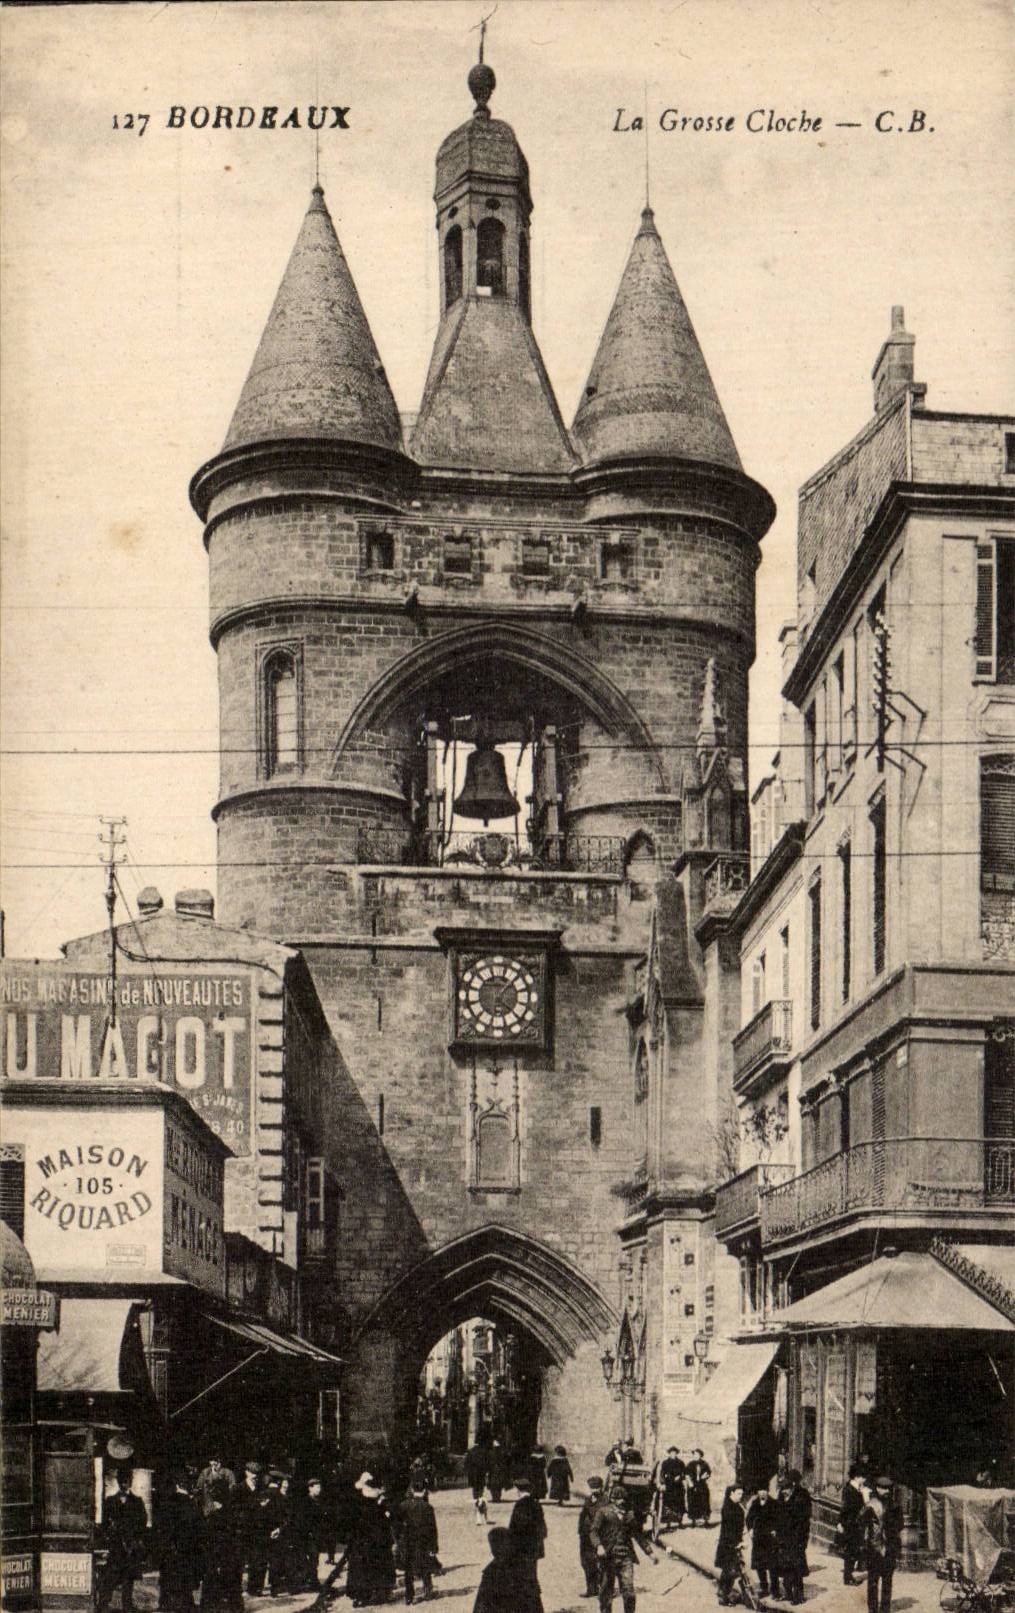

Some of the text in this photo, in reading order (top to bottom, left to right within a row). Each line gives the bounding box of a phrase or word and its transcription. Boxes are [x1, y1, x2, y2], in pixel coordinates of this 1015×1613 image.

[121, 981, 139, 1005] de
[143, 979, 242, 1006] NOUVEAUTES
[61, 1014, 247, 1089] MAGOT
[36, 1145, 148, 1178] MAISON
[30, 1186, 153, 1231] RIQUARD
[2, 1291, 52, 1306] CHOCOLAT
[3, 1306, 49, 1321] MENIER
[42, 1559, 89, 1573] CHOCOLAT
[43, 1574, 87, 1589] MENIER
